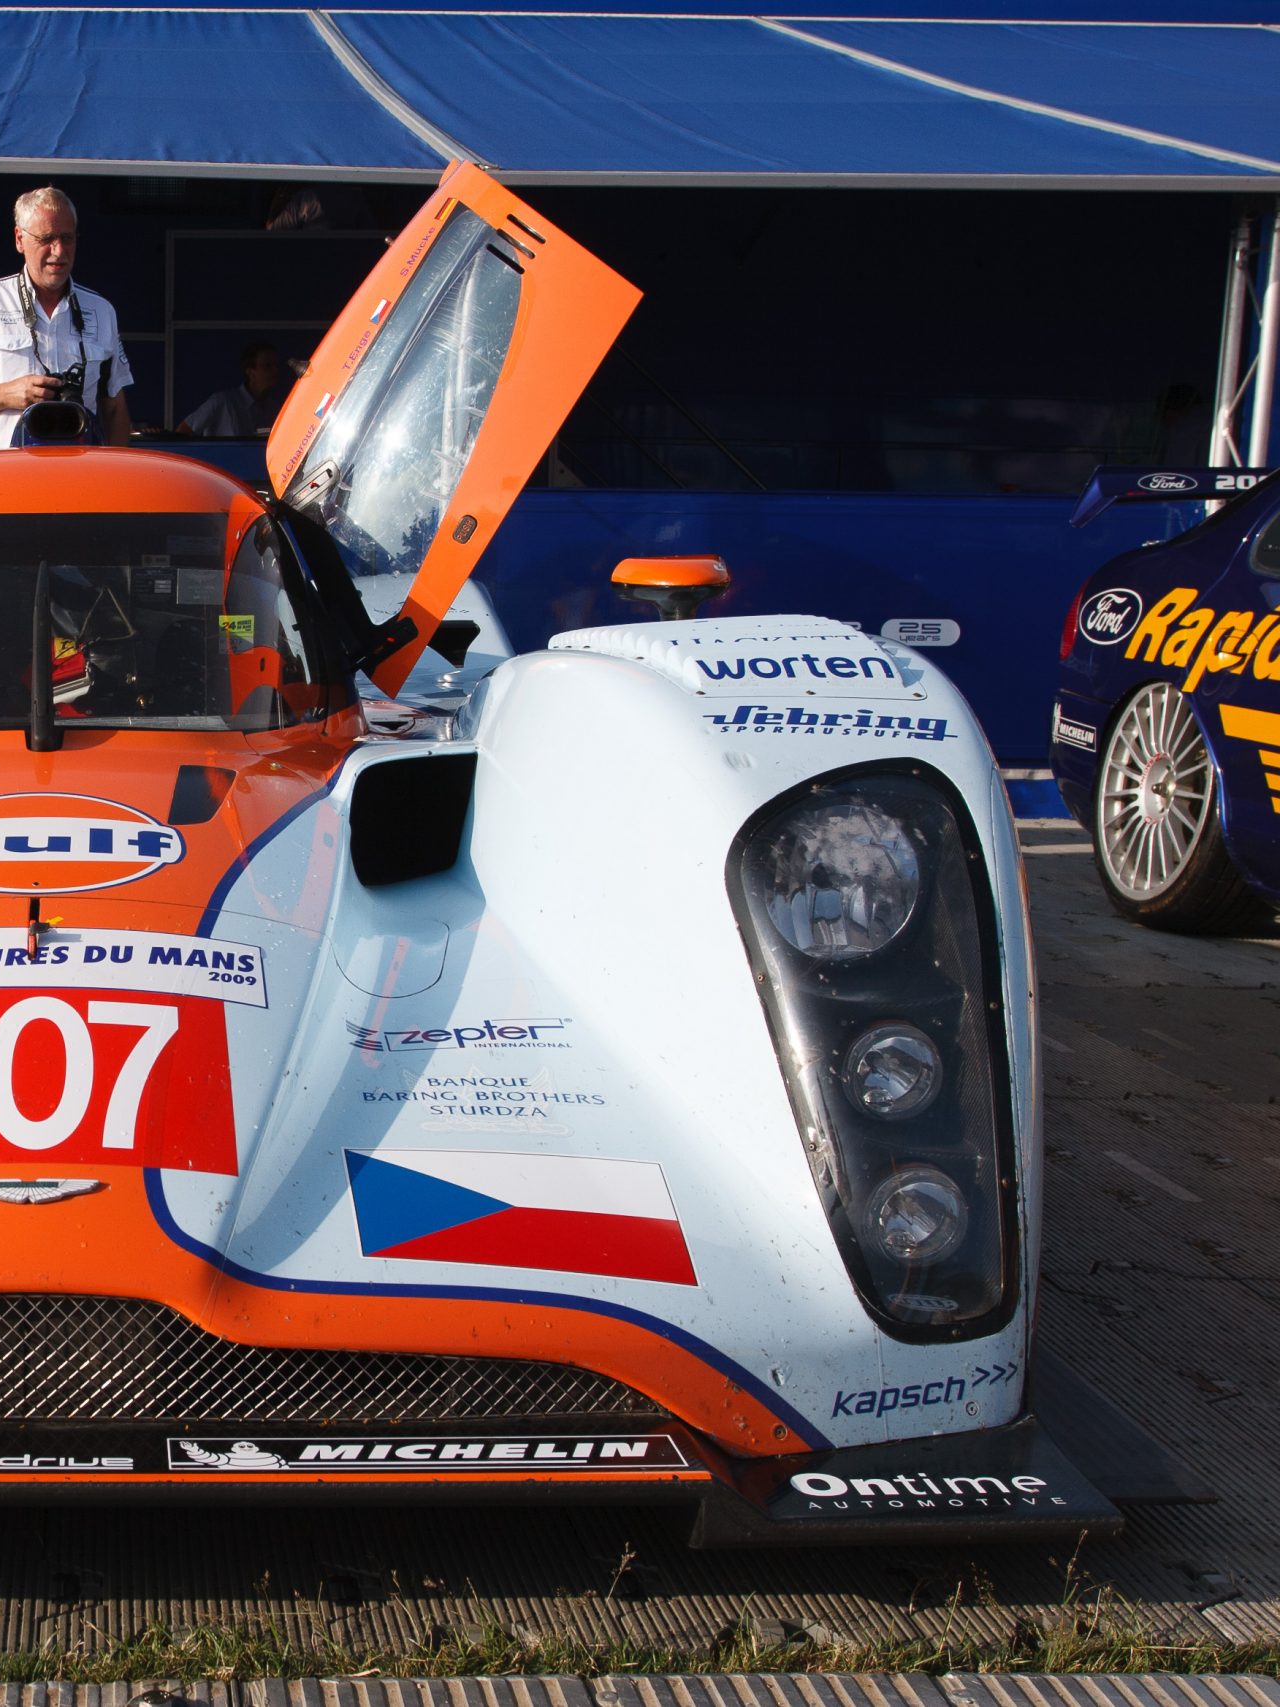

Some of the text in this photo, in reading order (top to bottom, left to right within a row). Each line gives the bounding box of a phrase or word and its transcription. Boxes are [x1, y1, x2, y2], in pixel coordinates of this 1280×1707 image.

[343, 330, 372, 370] T.Enge
[1149, 476, 1186, 490] Ford
[1086, 593, 1132, 635] Ford
[898, 622, 942, 634] 25
[899, 634, 942, 643] years
[695, 653, 894, 680] worten
[703, 705, 958, 742] Sebring
[1059, 722, 1095, 744] MICHELIN
[82, 945, 134, 965] DU
[148, 945, 256, 973] MANS
[207, 971, 257, 987] 2009
[400, 1019, 565, 1049] zepter
[427, 1077, 532, 1088] BANQUE
[362, 1091, 606, 1105] BARING BROTHERS
[429, 1104, 548, 1118] STURDZA
[831, 1376, 966, 1418] kapsch
[298, 1442, 650, 1461] MICHELIN
[789, 1472, 1048, 1497] Ontime
[808, 1497, 1068, 1511] AUTOMOTIVE
